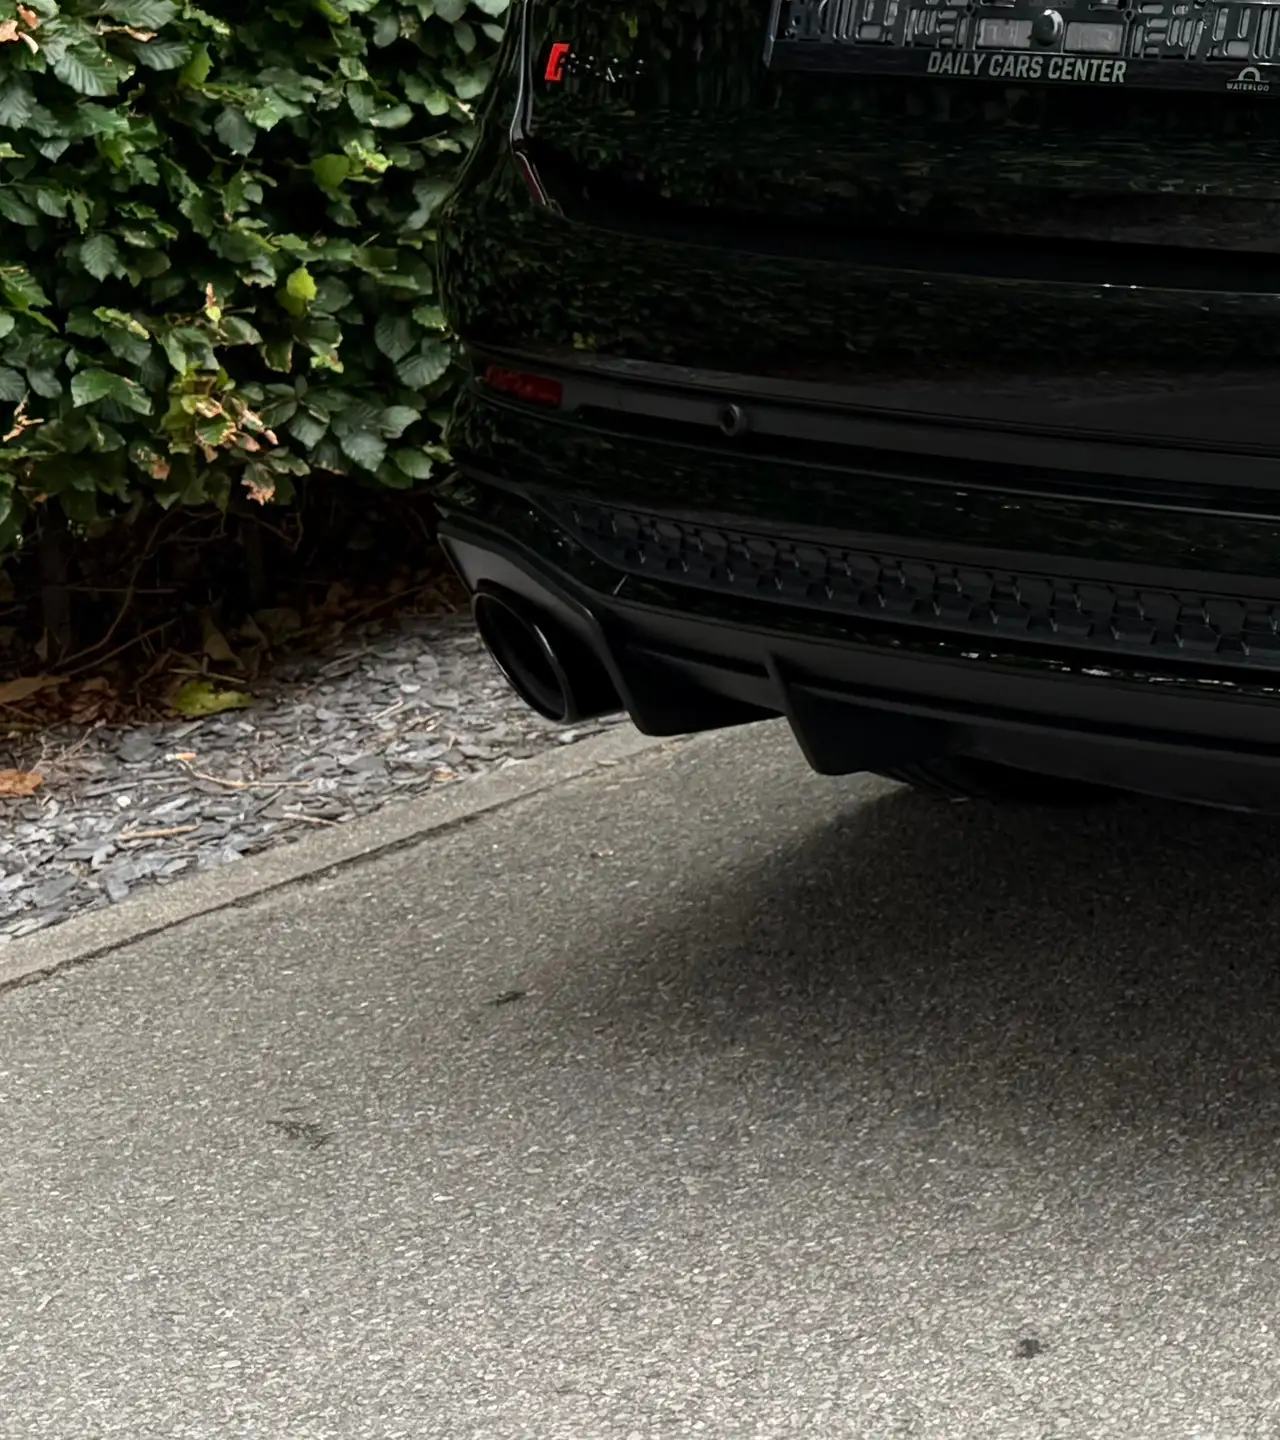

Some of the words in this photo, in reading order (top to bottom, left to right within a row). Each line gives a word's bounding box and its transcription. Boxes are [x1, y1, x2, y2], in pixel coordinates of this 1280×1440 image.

[927, 51, 986, 76] DAILY
[988, 54, 1043, 78] CARS
[1047, 58, 1127, 83] CENTER
[1226, 82, 1270, 92] WATERLOO
